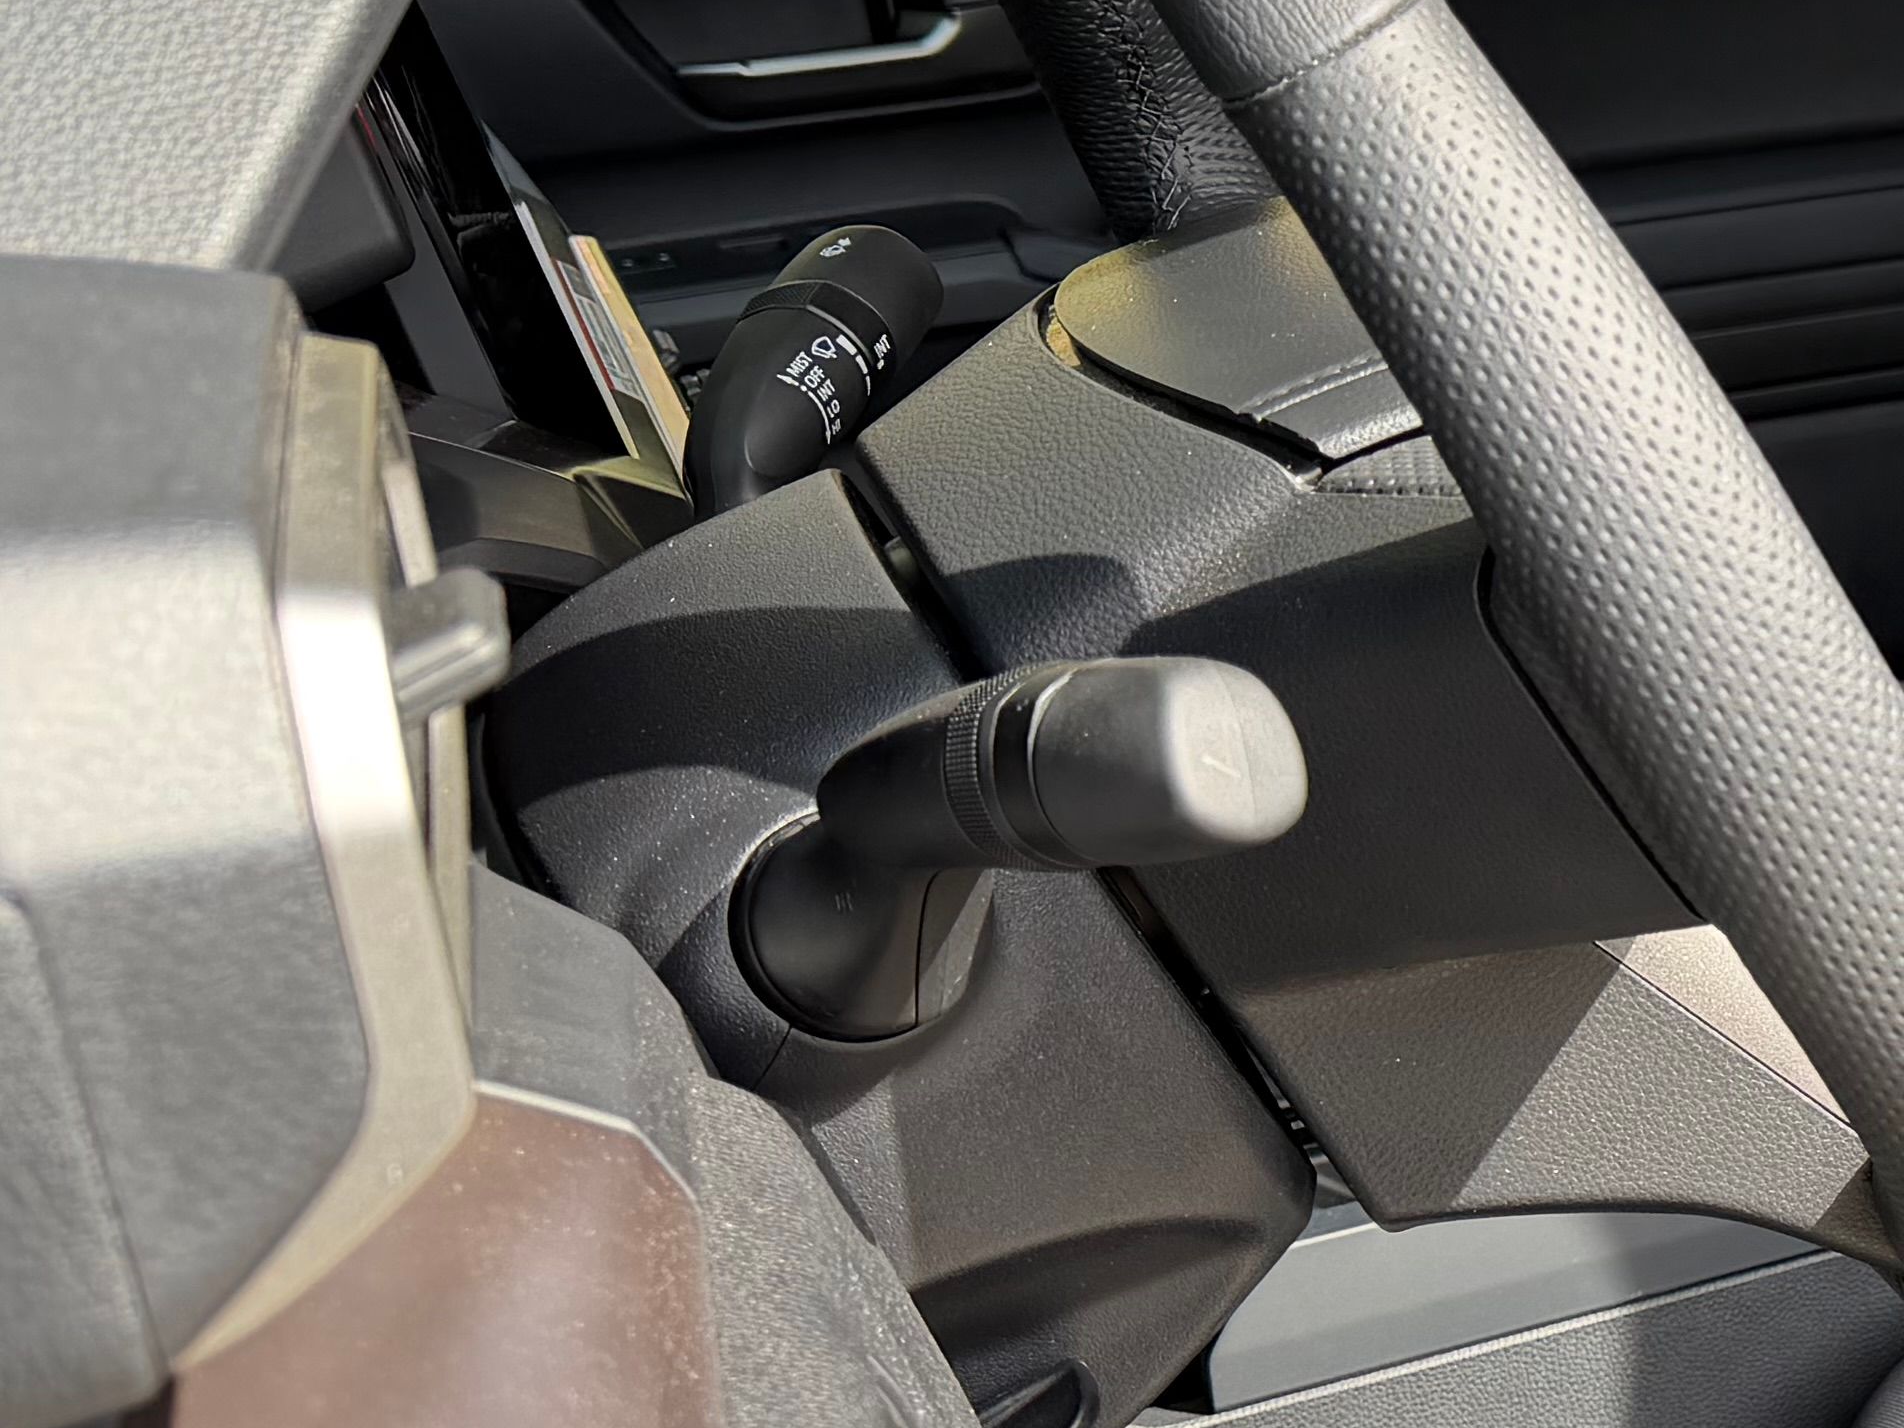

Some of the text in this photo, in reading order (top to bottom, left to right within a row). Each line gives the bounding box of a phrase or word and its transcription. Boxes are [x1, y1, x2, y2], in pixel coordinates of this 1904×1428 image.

[874, 334, 891, 357] INT
[786, 351, 814, 377] MIST
[804, 364, 826, 388] OFF
[817, 378, 836, 401] INT
[827, 399, 841, 418] LO
